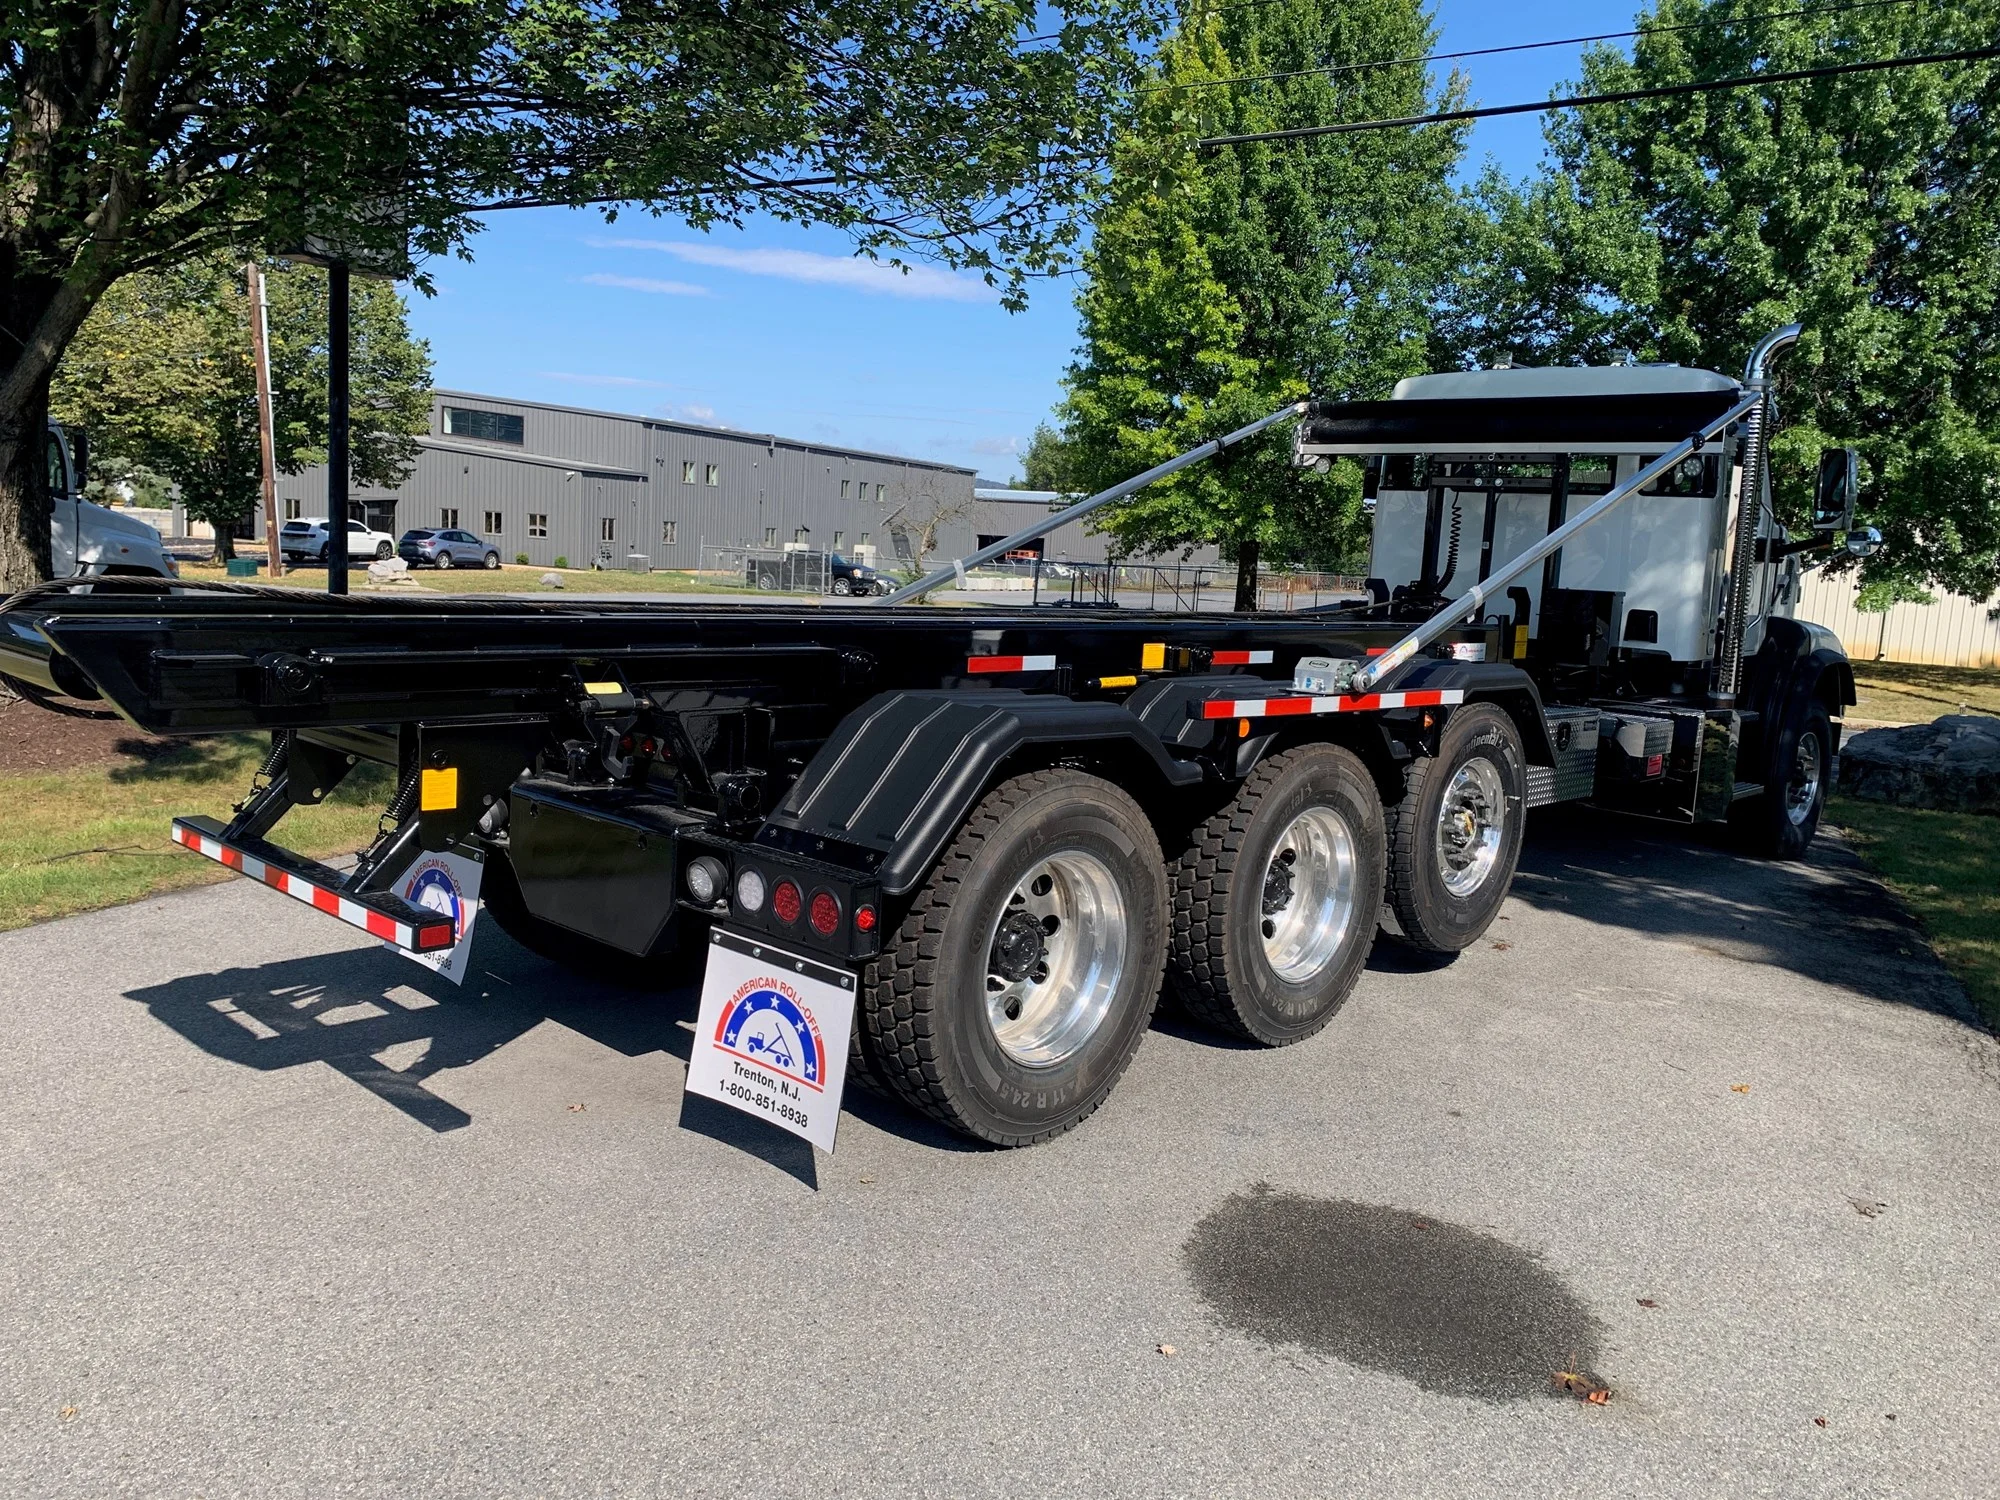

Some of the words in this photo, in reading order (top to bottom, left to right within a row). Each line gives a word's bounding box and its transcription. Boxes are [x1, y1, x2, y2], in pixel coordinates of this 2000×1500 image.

[412, 858, 440, 882] AMERICAN
[732, 976, 778, 1005] AMERICAN
[733, 1060, 778, 1093] Trenton,
[780, 1080, 801, 1102] N.J.
[719, 1079, 808, 1128] 1-800-851-8938
[1036, 1092, 1047, 1109] R
[1053, 1087, 1067, 1106] 11
